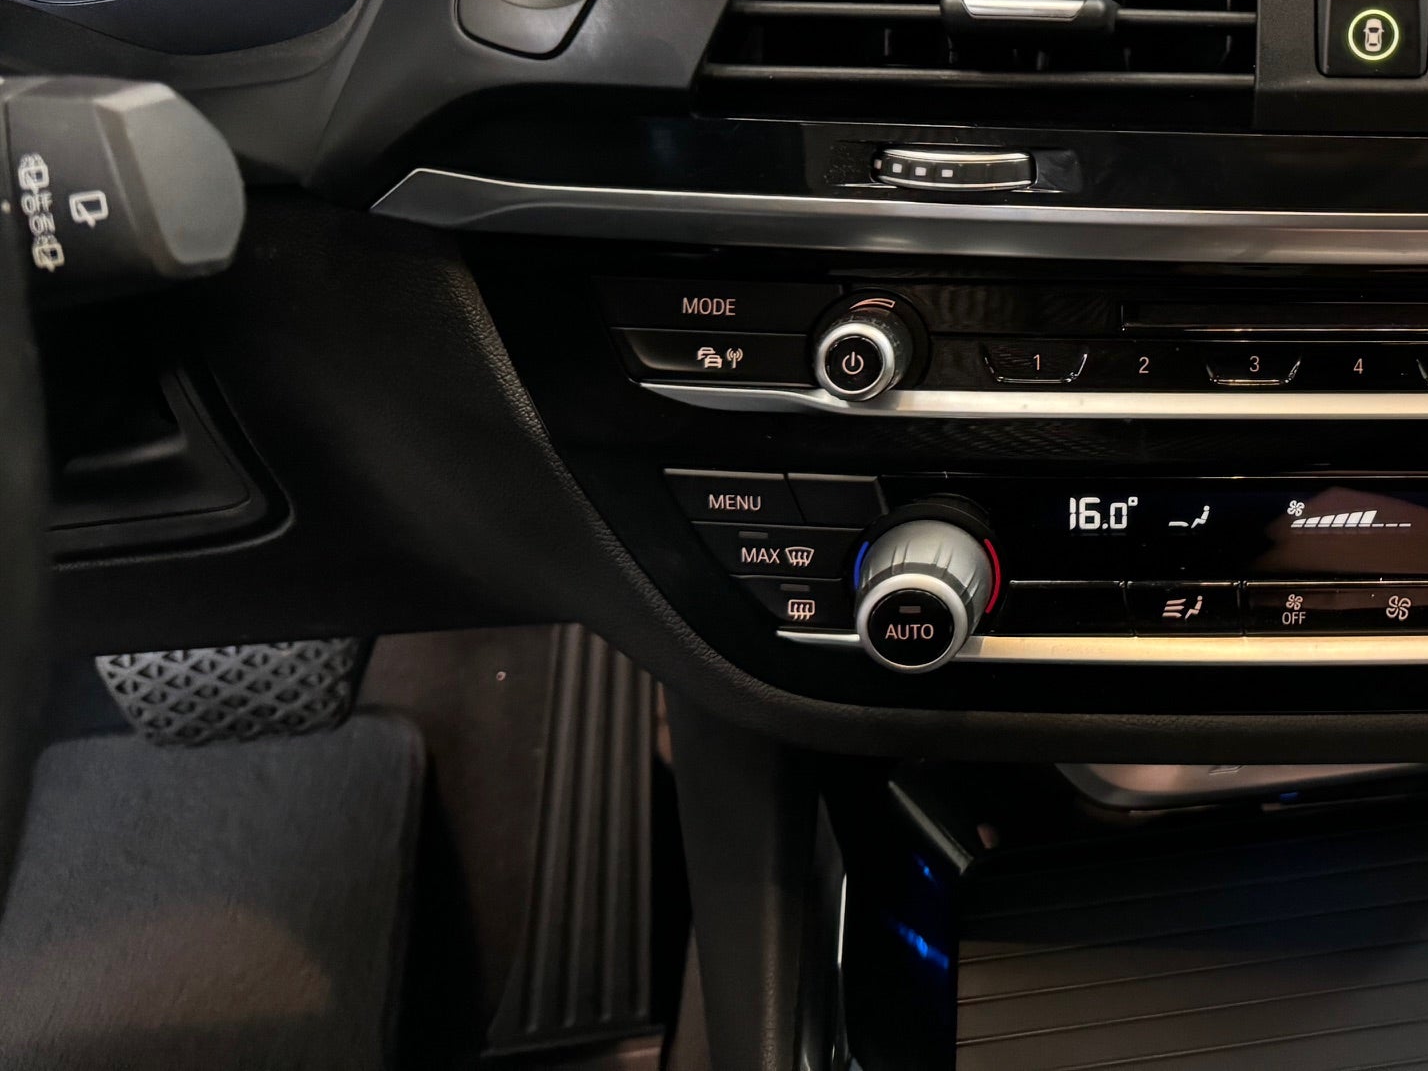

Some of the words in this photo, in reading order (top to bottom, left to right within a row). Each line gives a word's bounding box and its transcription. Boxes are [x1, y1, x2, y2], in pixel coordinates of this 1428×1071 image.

[29, 214, 56, 236] ON
[682, 297, 736, 316] MODE
[1032, 354, 1041, 371] 1
[1138, 356, 1150, 374] 2
[1249, 355, 1260, 373] 3
[1353, 357, 1364, 375] 4
[708, 494, 761, 511] MENU
[741, 547, 780, 564] MAX
[1281, 611, 1306, 625] OFF
[885, 623, 934, 640] AUTO
